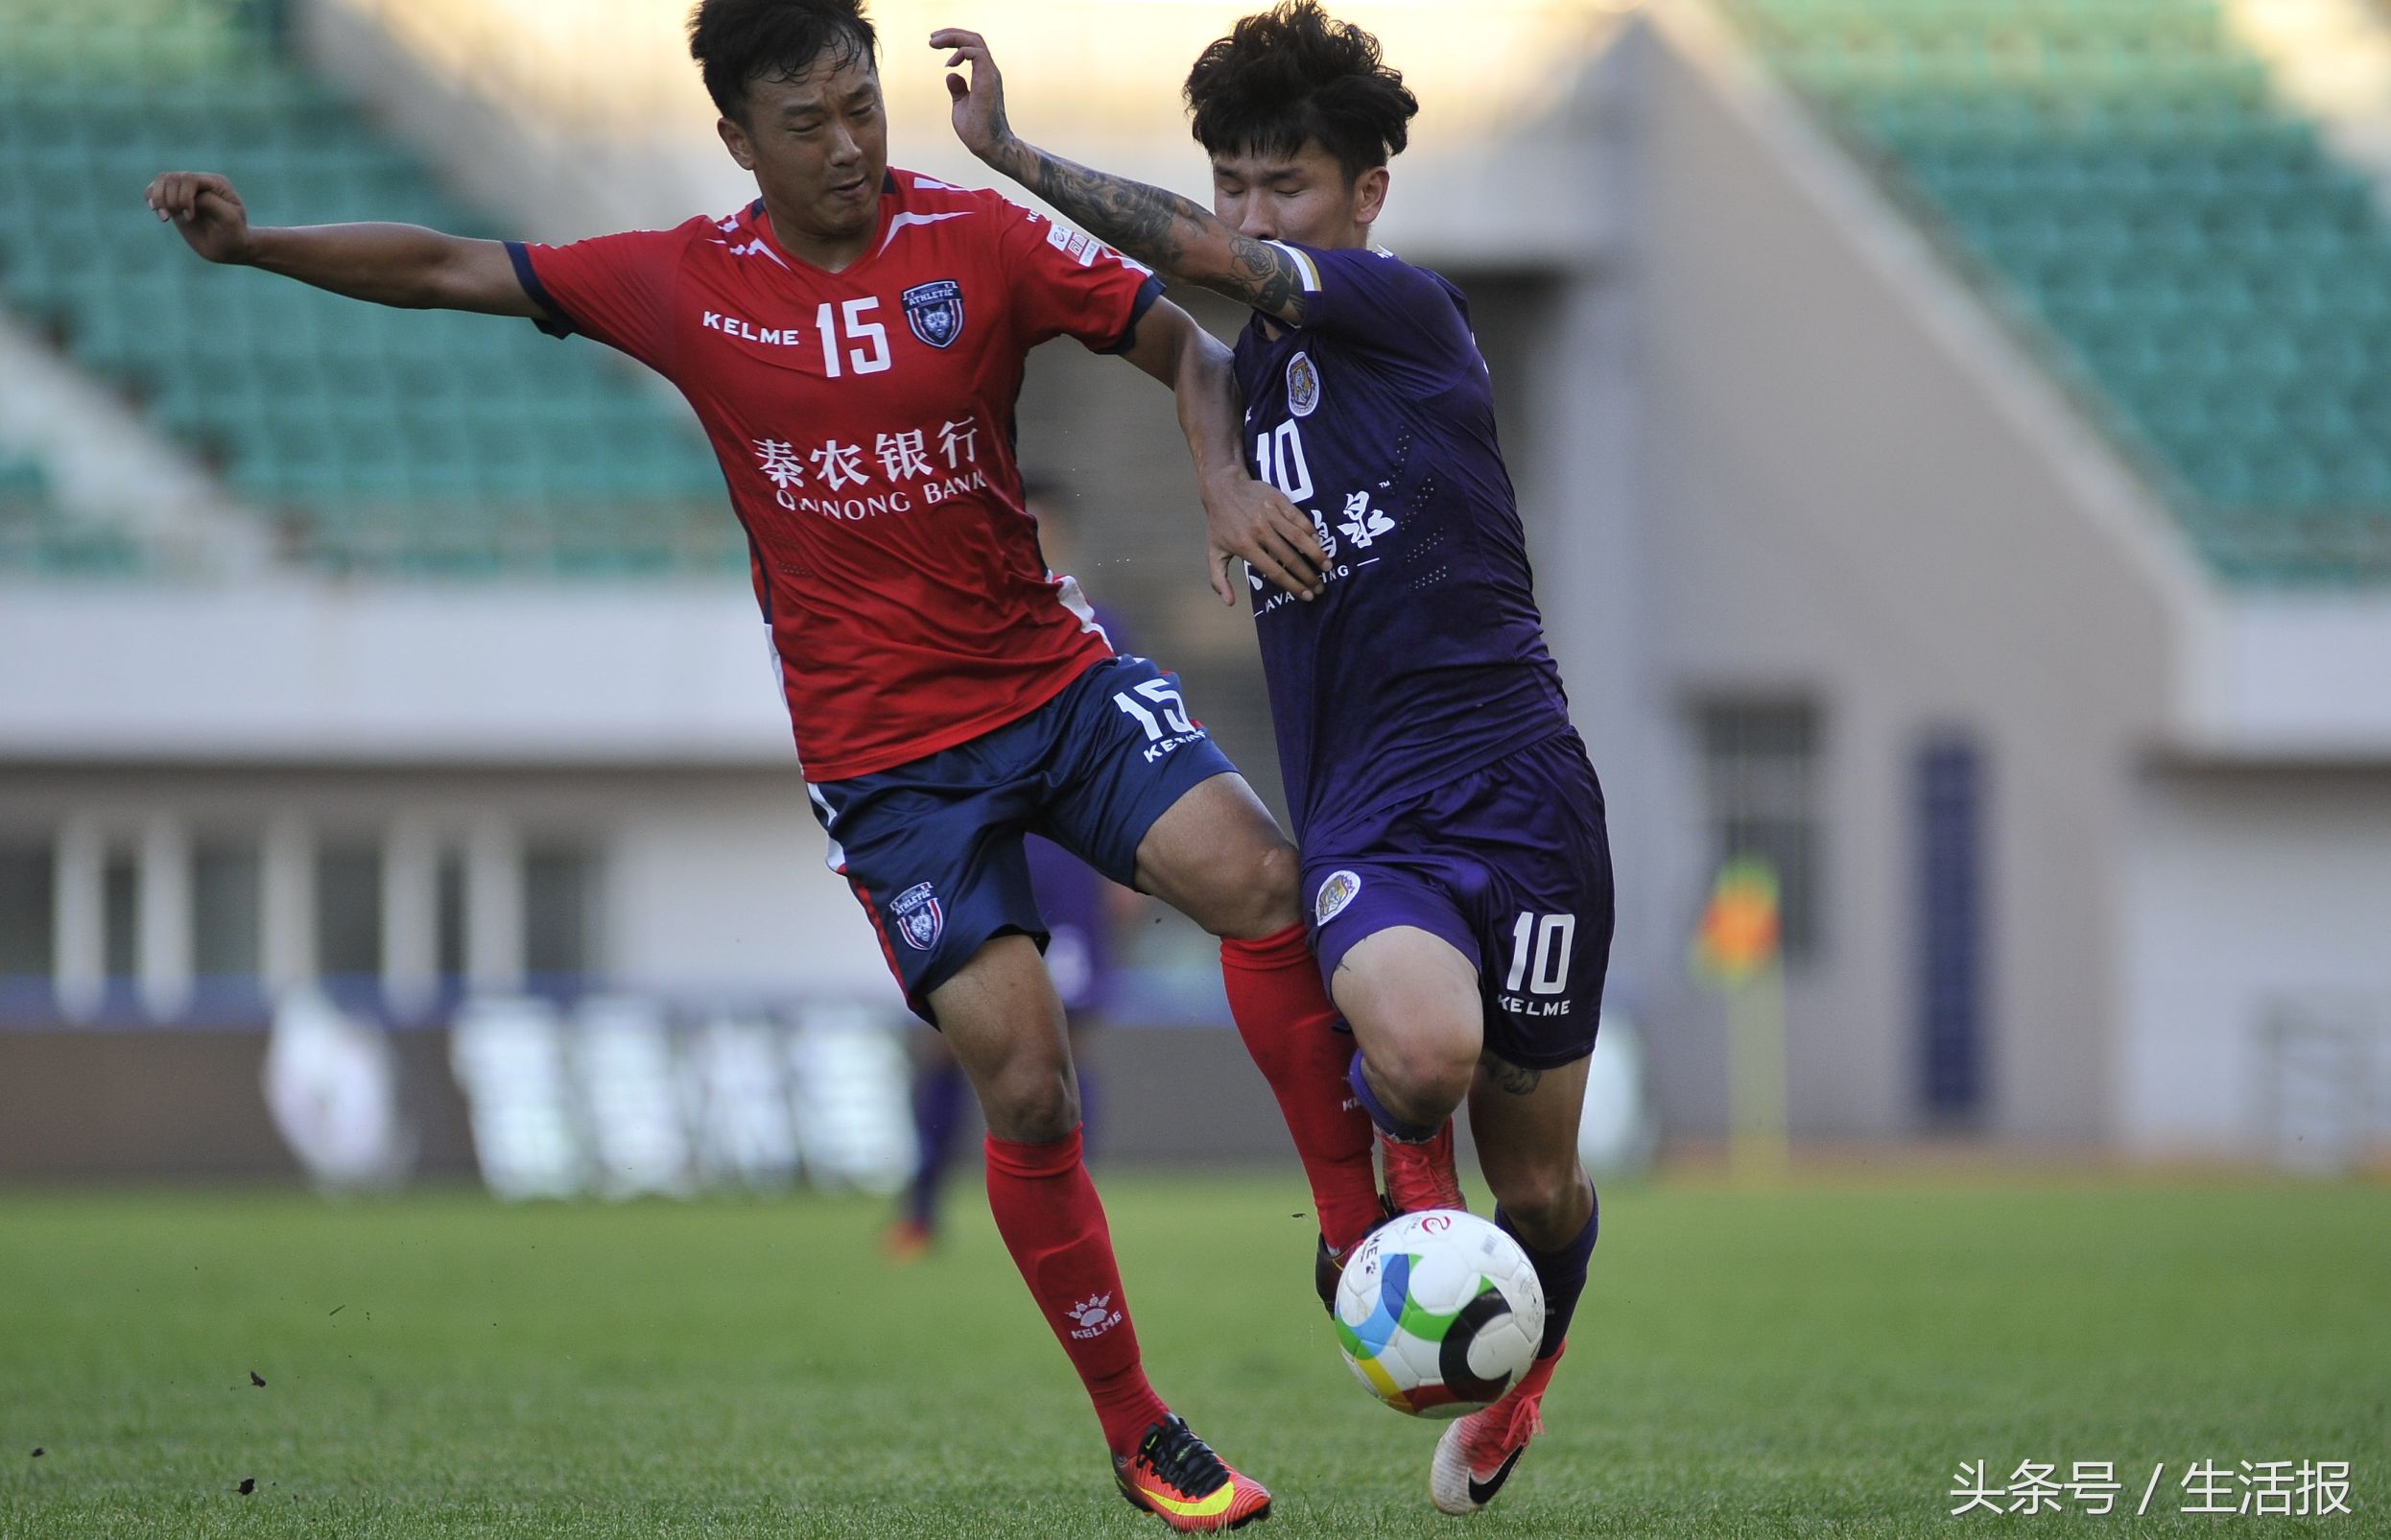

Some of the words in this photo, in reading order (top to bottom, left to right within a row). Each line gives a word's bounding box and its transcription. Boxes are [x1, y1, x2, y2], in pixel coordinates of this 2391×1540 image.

[909, 289, 954, 306] ATHLETIC
[702, 311, 799, 345] KELME
[816, 296, 891, 378] 15
[752, 416, 979, 492] 秦农银行
[1256, 418, 1314, 504] 10
[922, 470, 987, 504] BANK
[1113, 678, 1196, 742] 15
[1506, 912, 1575, 994] 10
[1497, 994, 1571, 1016] KELME
[1071, 1311, 1123, 1339] KELME
